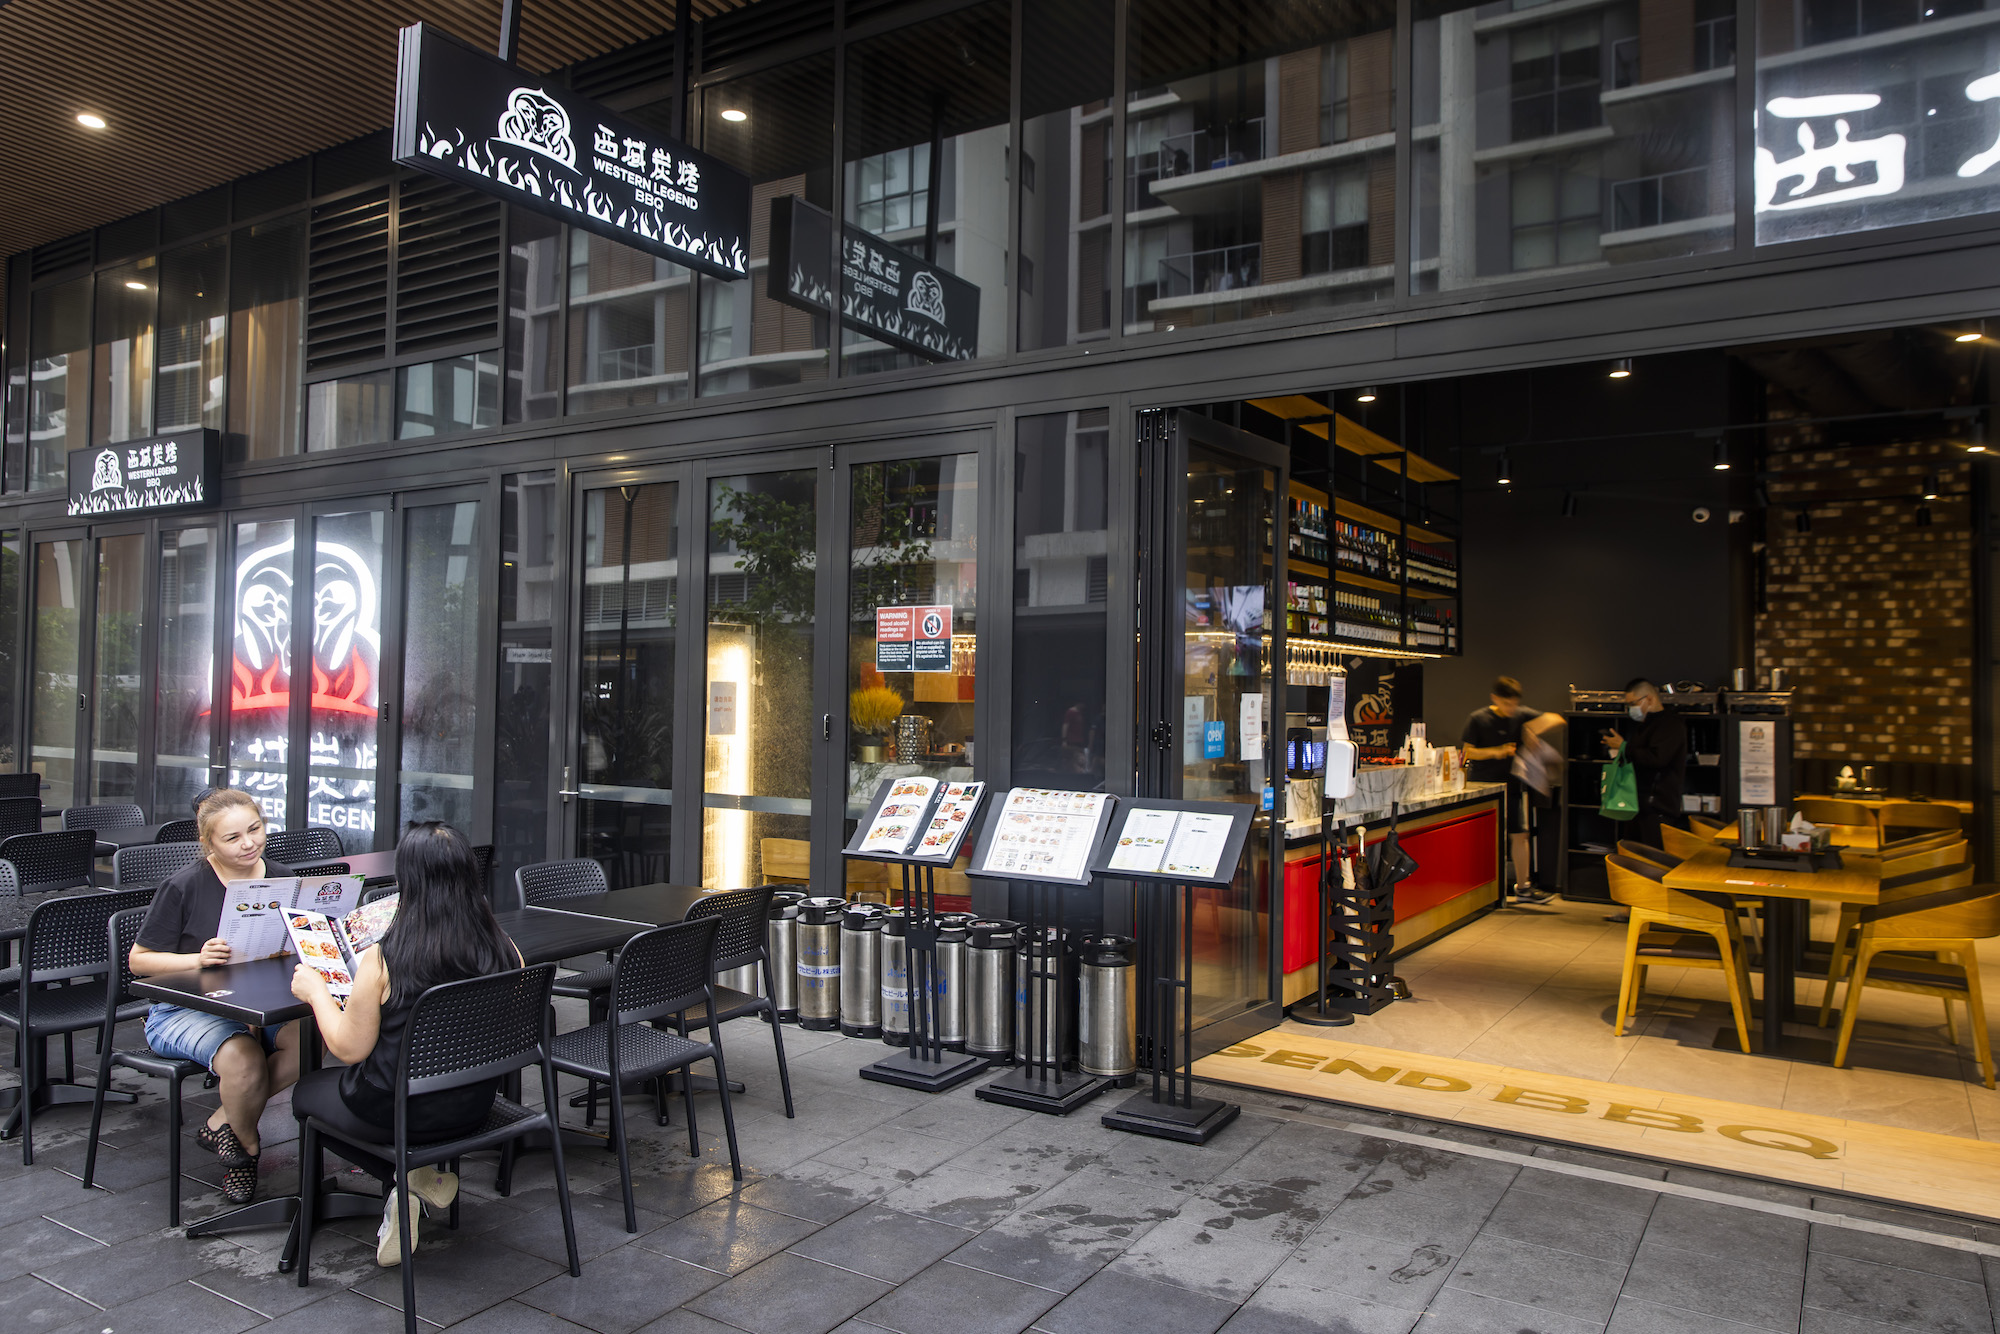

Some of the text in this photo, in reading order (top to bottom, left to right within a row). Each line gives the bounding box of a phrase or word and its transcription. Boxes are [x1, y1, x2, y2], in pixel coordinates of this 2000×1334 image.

[1754, 70, 2000, 214] 西
[593, 123, 700, 194] 西域炭烤
[593, 156, 699, 210] WESTERN LEGEND
[635, 188, 665, 212] BBQ
[127, 441, 178, 469] 西域炭烤
[127, 465, 178, 480] WESTERN LEGEND
[146, 477, 161, 488] BBQ
[1207, 729, 1223, 742] OPEN
[308, 802, 376, 831] LEGEN
[1490, 1084, 1840, 1159] BBQ
